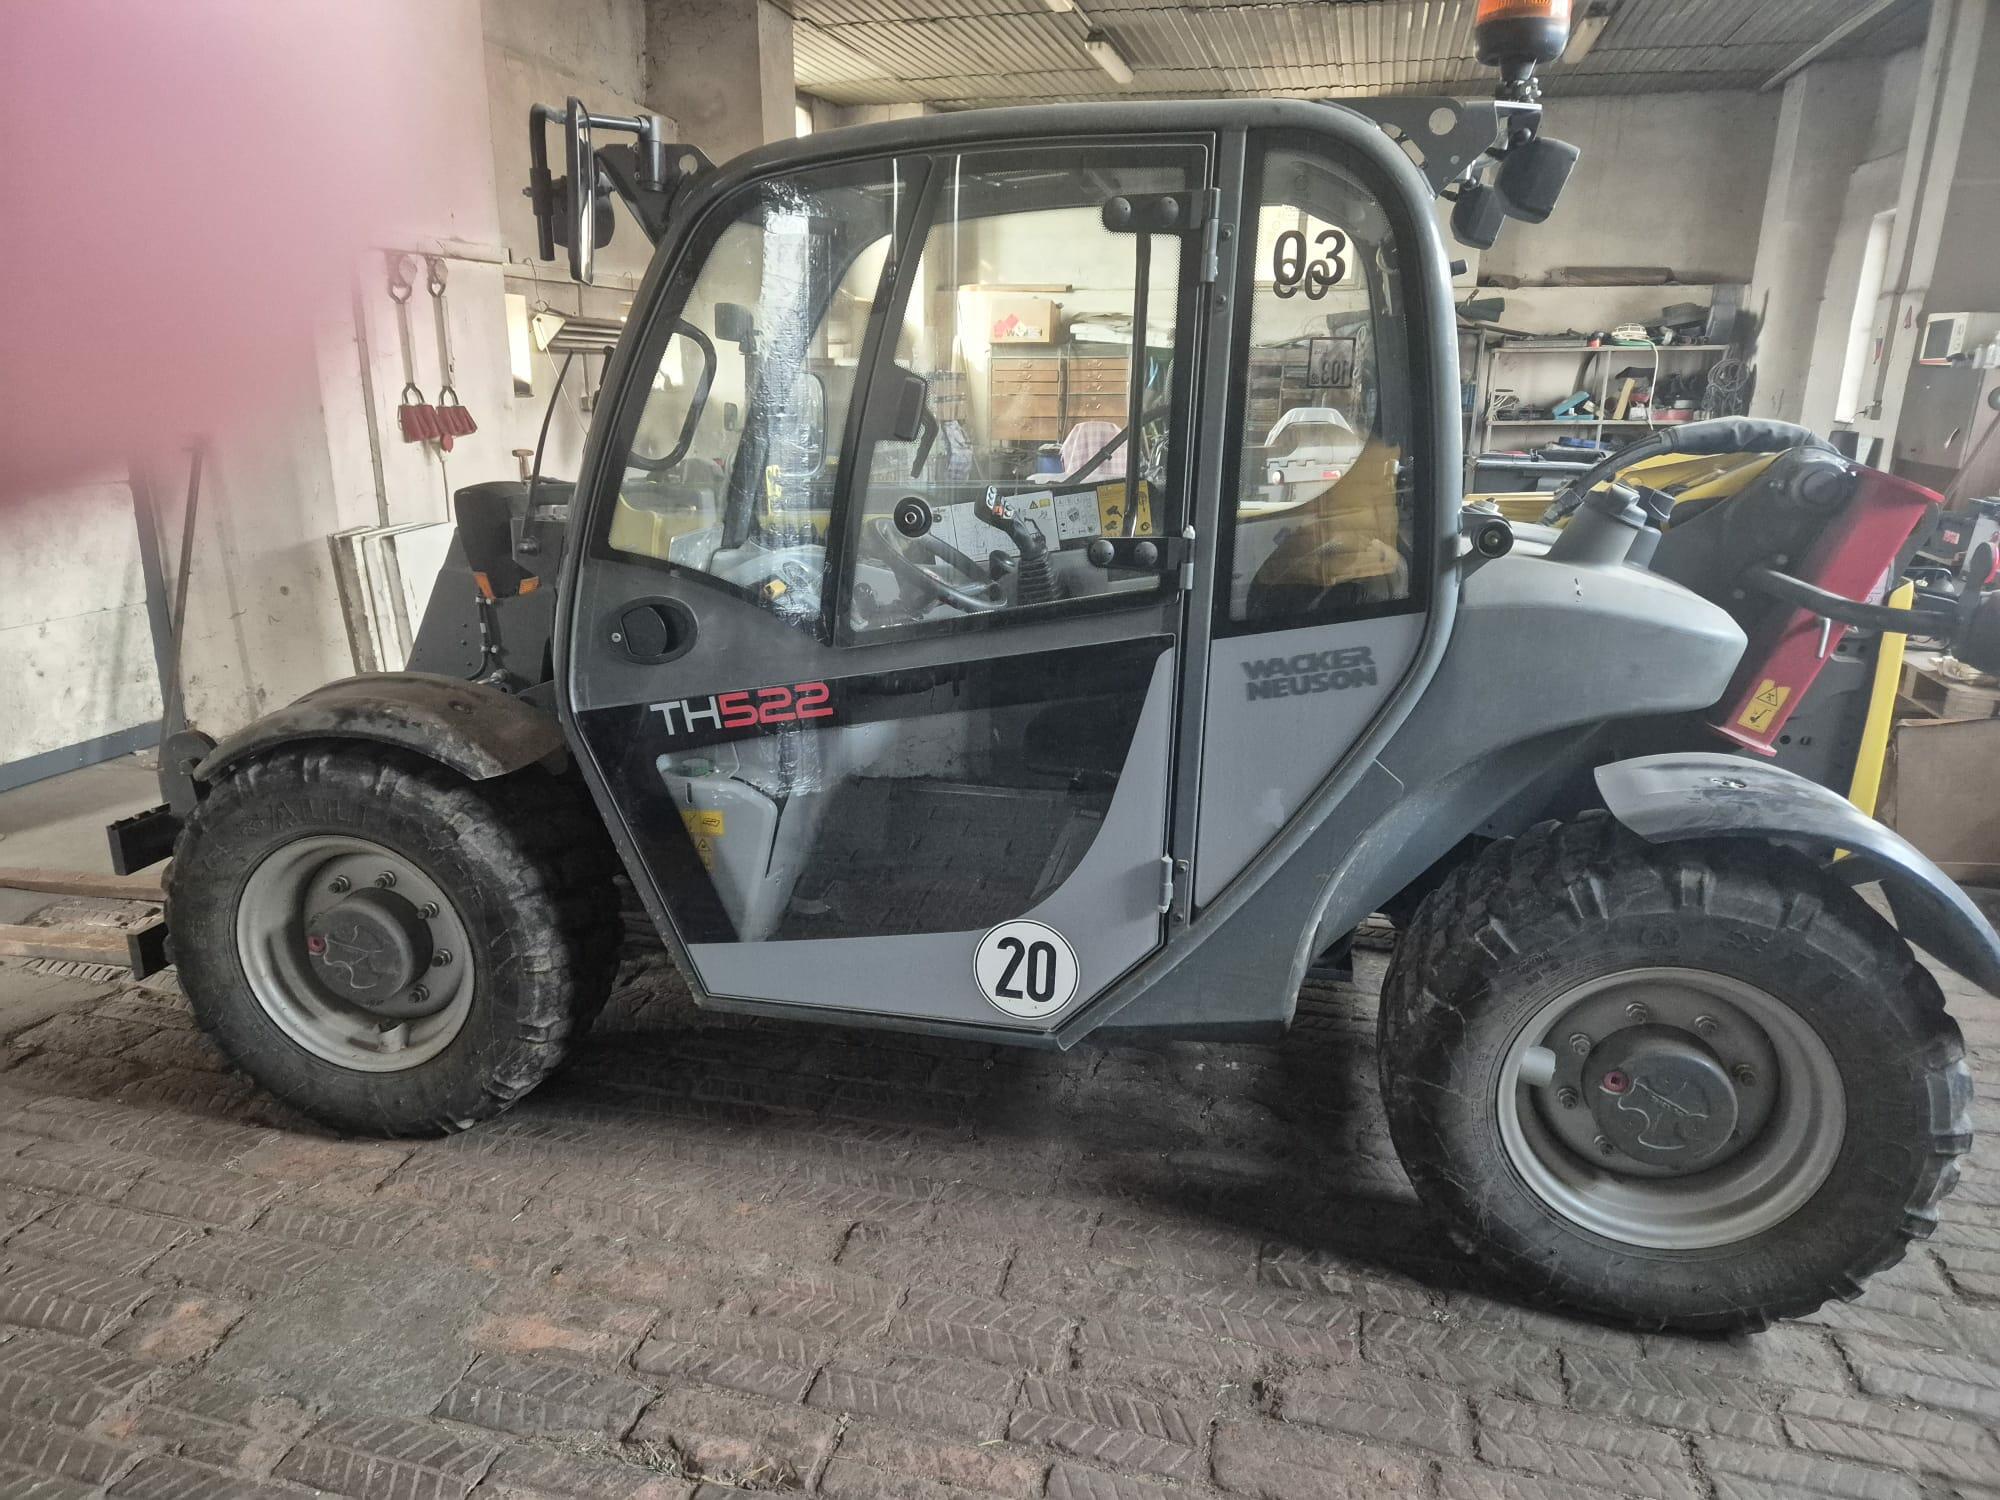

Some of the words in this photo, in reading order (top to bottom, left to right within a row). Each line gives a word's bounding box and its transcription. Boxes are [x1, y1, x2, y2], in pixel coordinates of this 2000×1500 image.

[1273, 230, 1346, 286] 03
[1240, 646, 1377, 681] WACKER
[1246, 665, 1378, 701] NEUSON
[649, 682, 834, 736] TH522
[995, 936, 1057, 1003] 20
